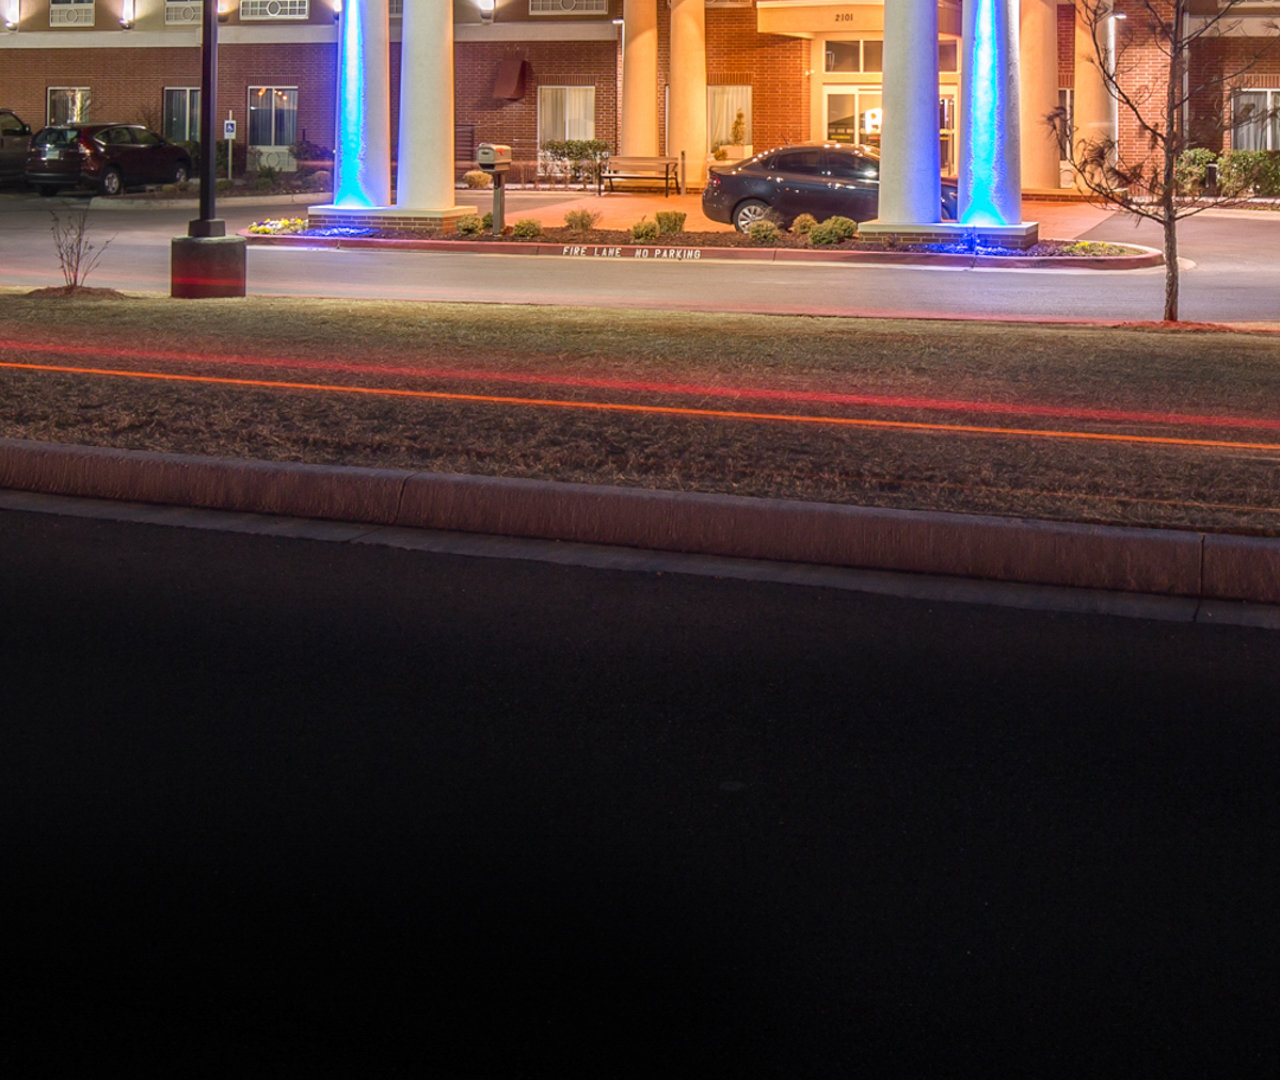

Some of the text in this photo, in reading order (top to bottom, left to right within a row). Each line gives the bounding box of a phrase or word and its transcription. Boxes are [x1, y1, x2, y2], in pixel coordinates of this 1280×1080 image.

[835, 13, 853, 22] 2101
[562, 245, 701, 260] FIRE LANE NO PARKING
